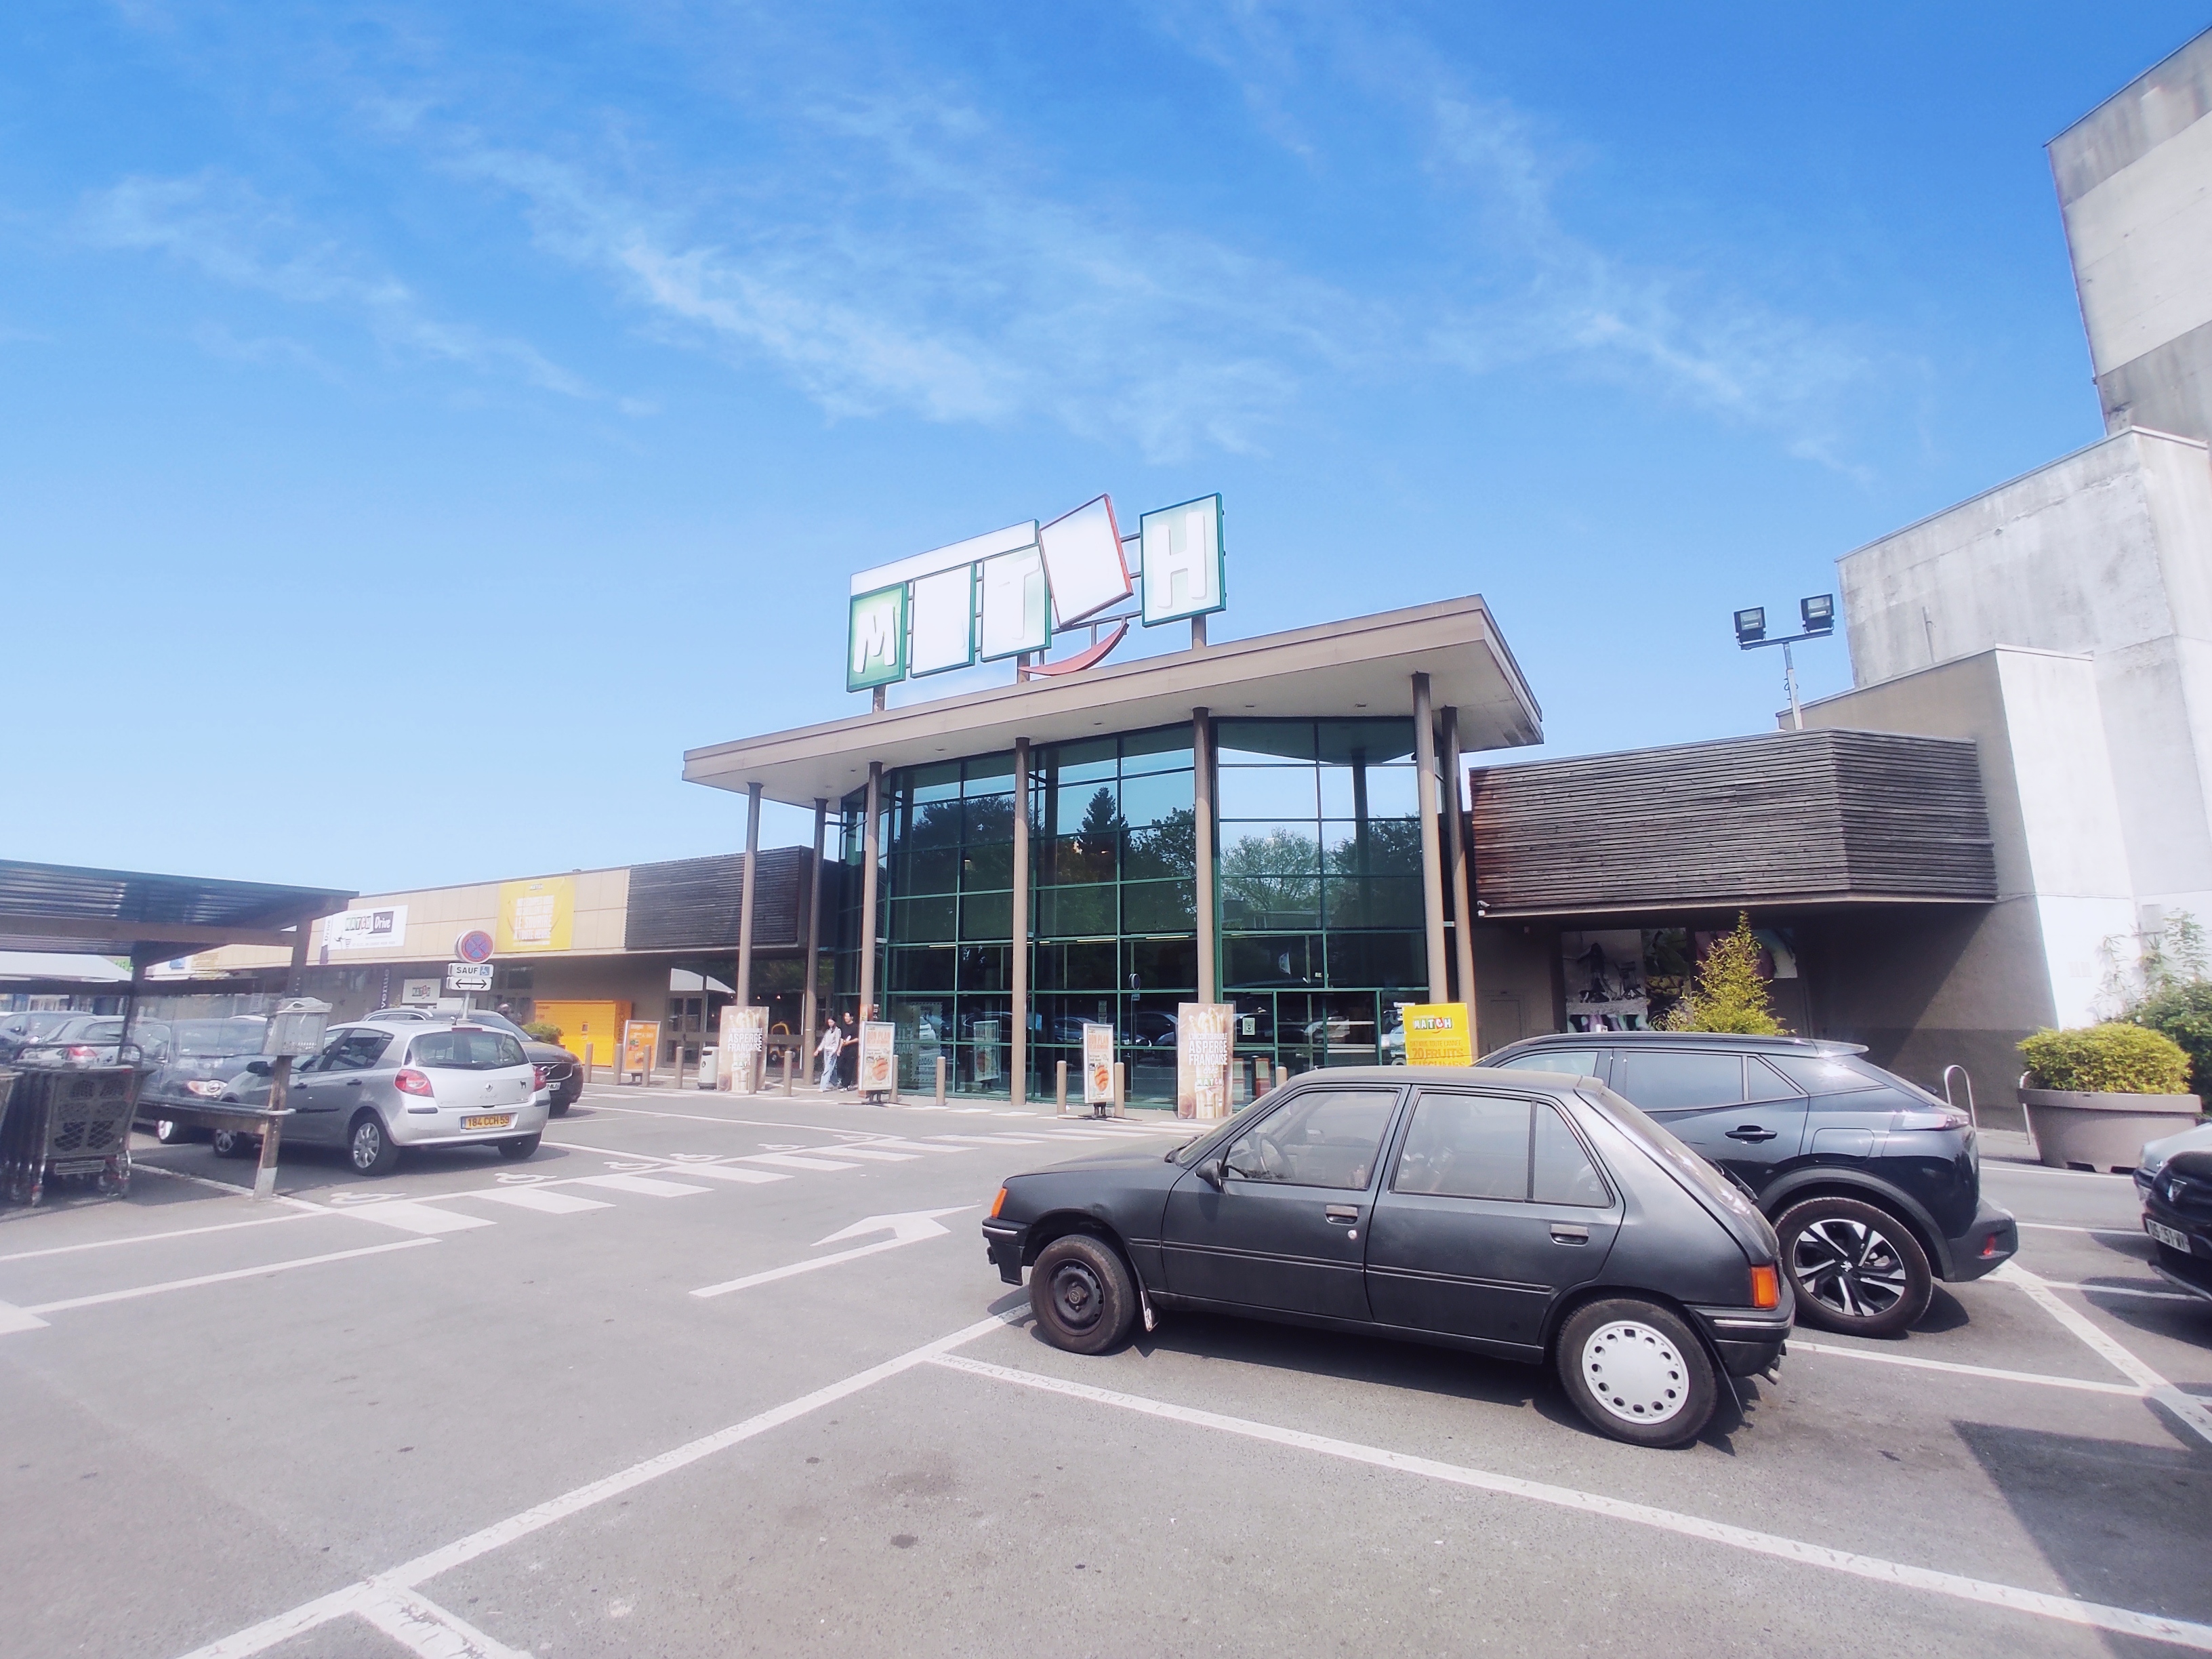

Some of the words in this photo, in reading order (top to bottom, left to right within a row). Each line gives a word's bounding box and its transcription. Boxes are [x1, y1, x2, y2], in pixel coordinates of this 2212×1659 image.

[853, 510, 1208, 674] MTH
[346, 916, 371, 931] MATCH
[375, 916, 391, 929] Drive
[1414, 1017, 1453, 1029] MATCH
[728, 1033, 762, 1043] ASPERGE
[878, 1031, 890, 1040] PLAN
[727, 1043, 762, 1052] FRANÇAISE
[1189, 1040, 1228, 1054] ASPERGE
[1412, 1048, 1425, 1058] 20
[1425, 1048, 1464, 1059] FRUITS
[1189, 1054, 1228, 1067] FRANÇAISE
[1203, 1065, 1219, 1075] chez
[1197, 1078, 1223, 1086] MATCH
[468, 1118, 482, 1127] 184
[484, 1115, 499, 1126] CCH
[500, 1115, 510, 1124] 59
